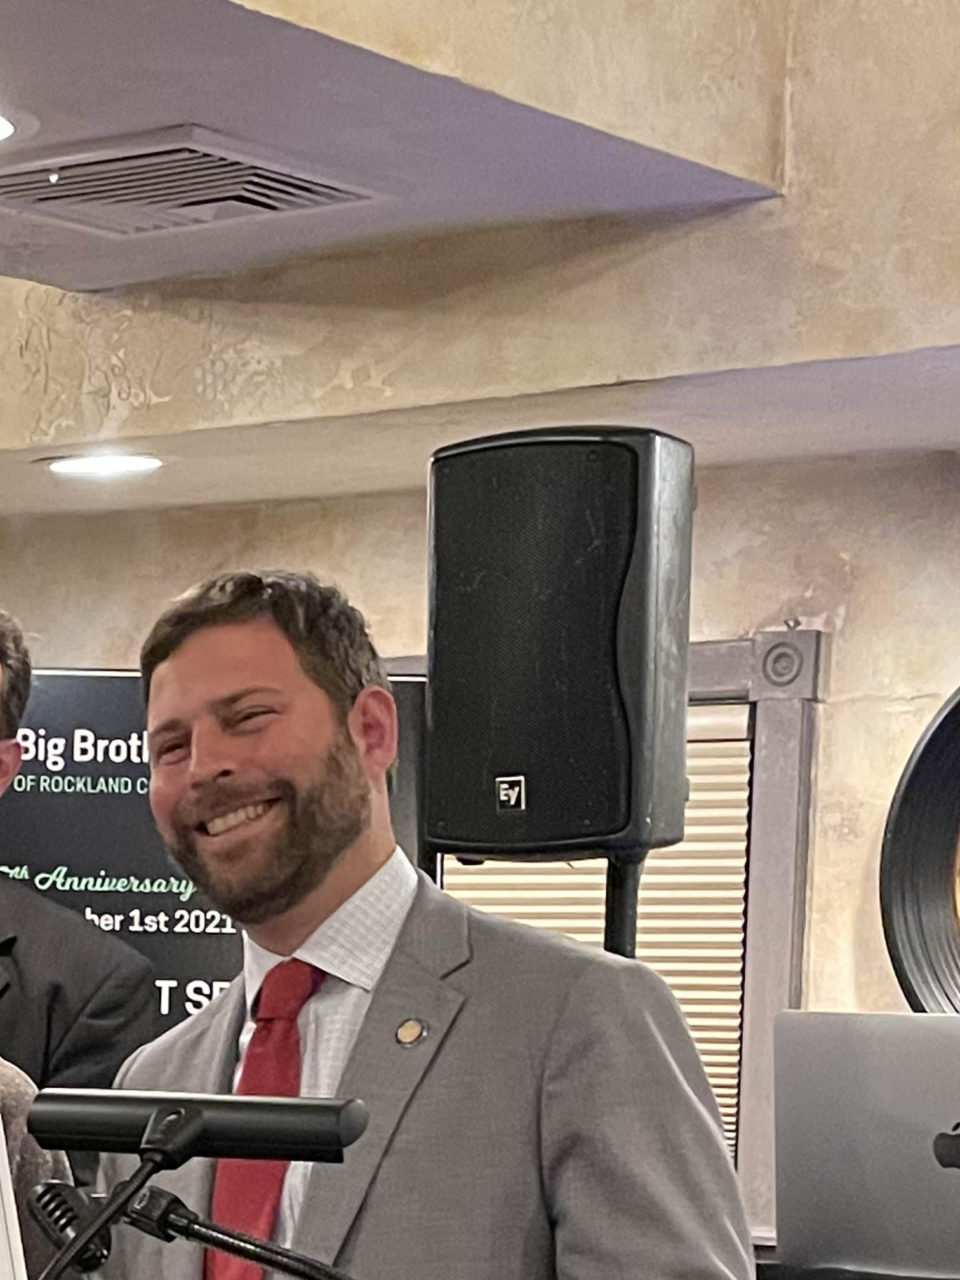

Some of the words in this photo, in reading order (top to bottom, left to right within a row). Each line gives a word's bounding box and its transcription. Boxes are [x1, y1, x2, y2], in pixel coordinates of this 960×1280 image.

[16, 728, 66, 771] Big
[13, 775, 36, 792] OF
[40, 776, 132, 794] ROCKLAND
[34, 866, 197, 901] Anniversary
[128, 909, 169, 933] 1st
[173, 909, 237, 934] 2021
